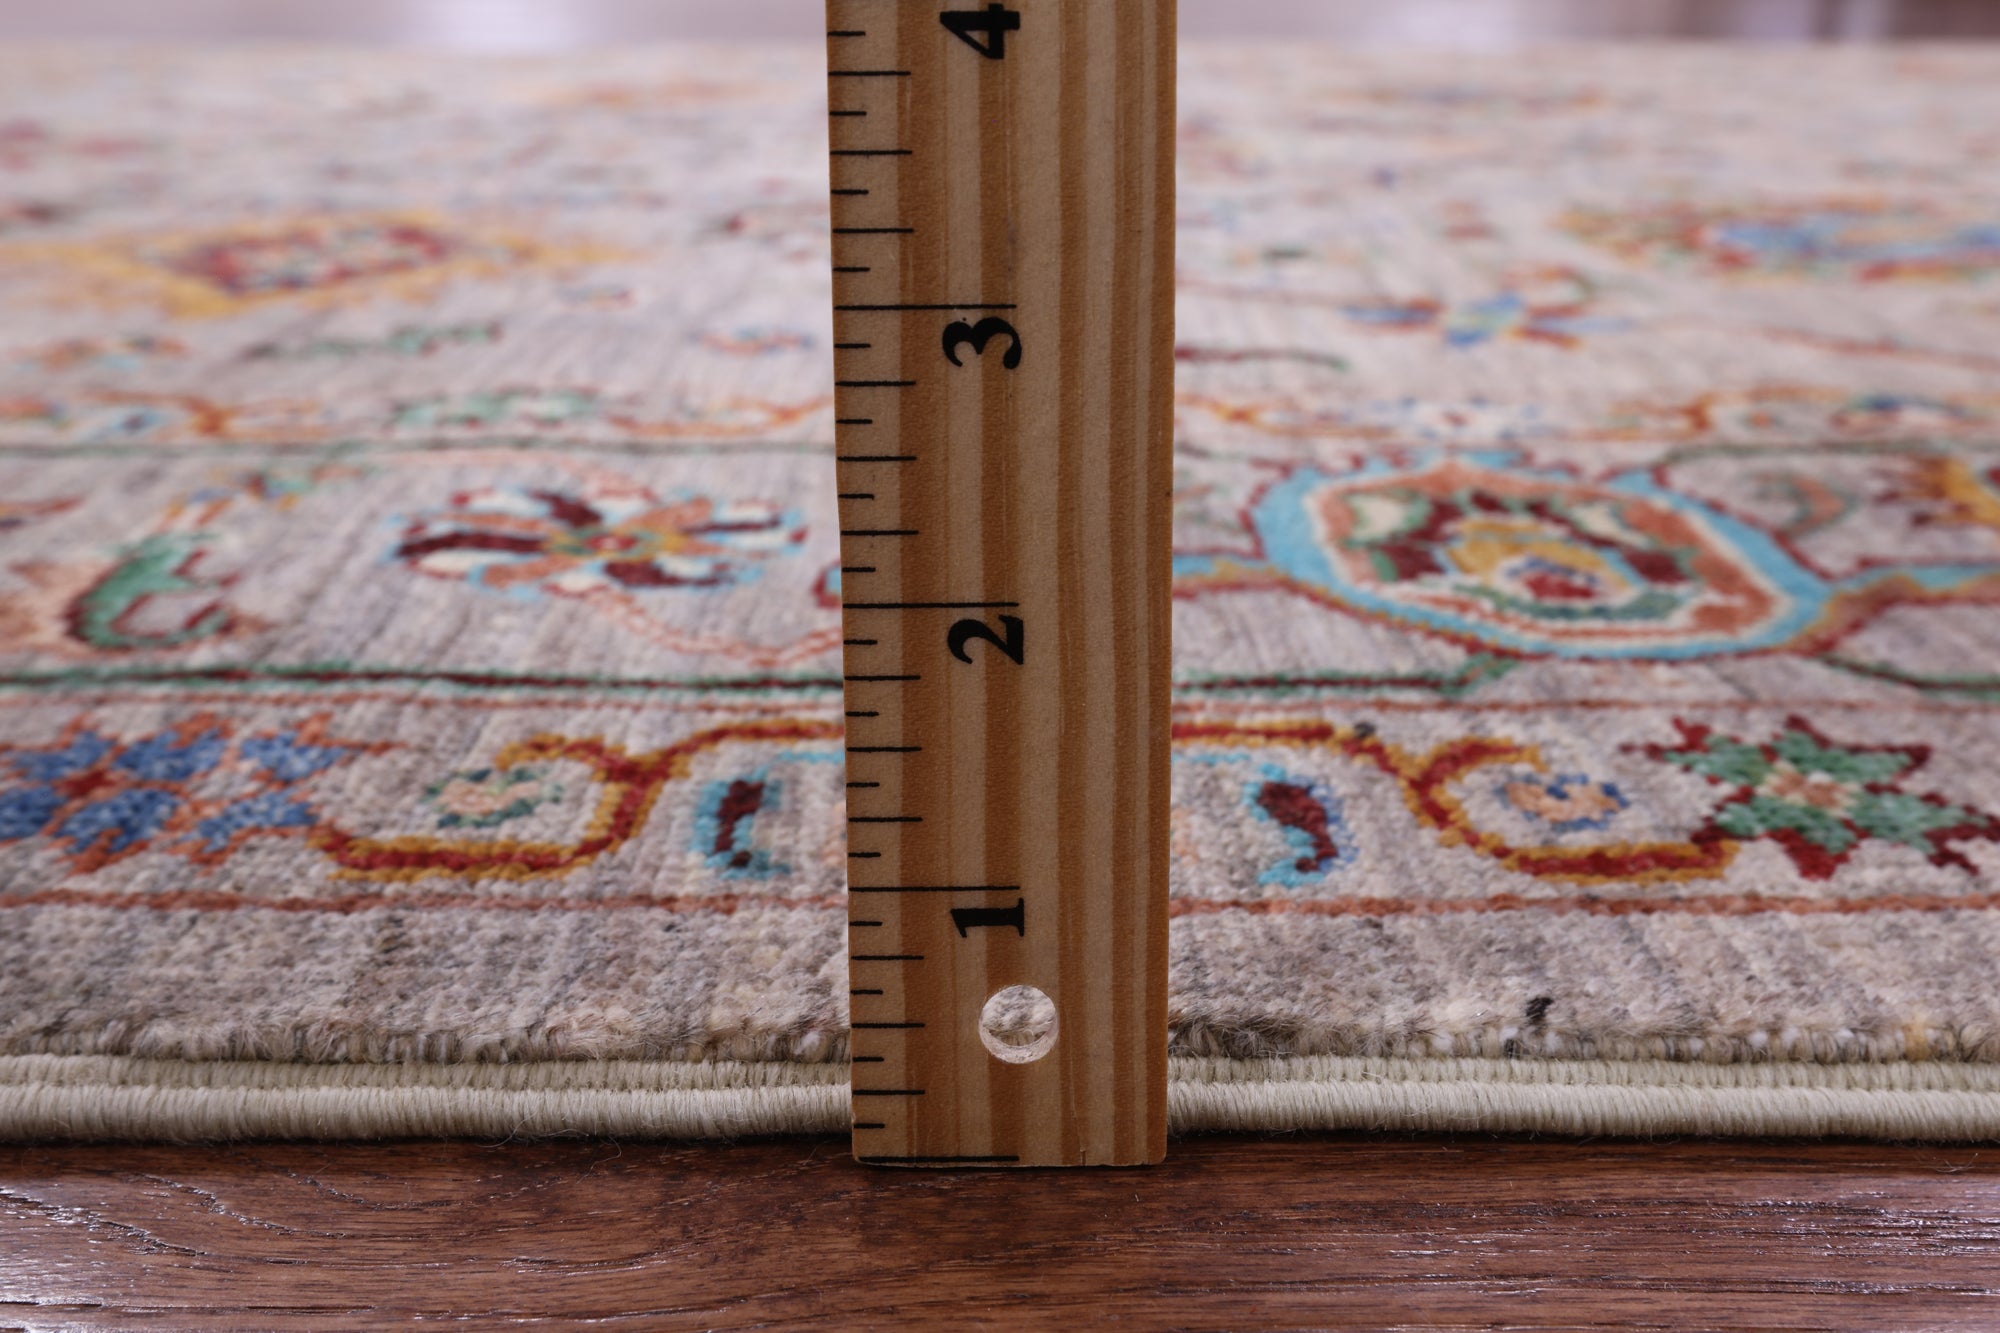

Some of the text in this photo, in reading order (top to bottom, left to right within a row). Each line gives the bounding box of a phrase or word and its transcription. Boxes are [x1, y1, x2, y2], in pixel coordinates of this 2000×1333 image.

[940, 3, 1020, 59] 4
[942, 317, 1022, 370] 3
[947, 614, 1025, 665] 2
[950, 897, 1025, 938] 1
